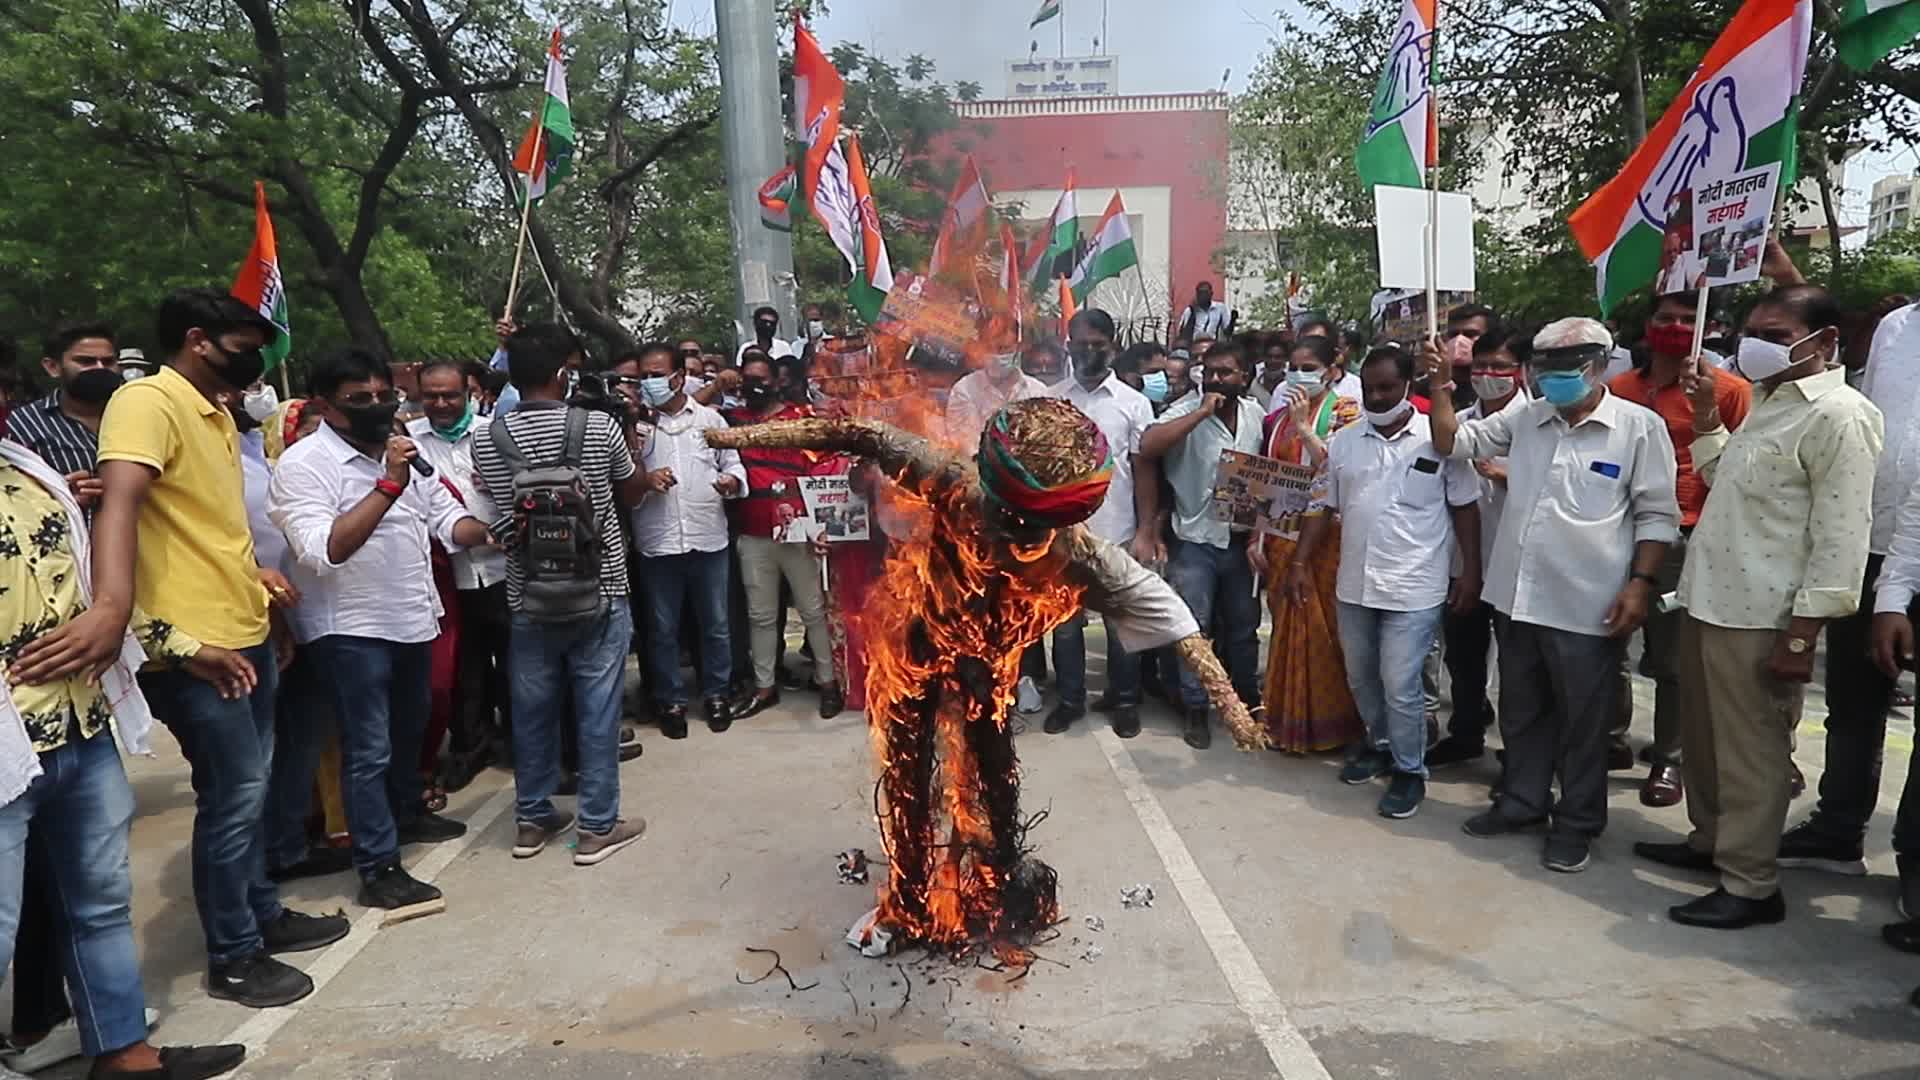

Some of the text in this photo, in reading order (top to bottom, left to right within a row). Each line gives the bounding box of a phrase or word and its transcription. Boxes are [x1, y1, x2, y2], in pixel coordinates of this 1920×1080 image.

[1698, 172, 1769, 204] मोदी मतलब
[1707, 196, 1748, 224] महंगाई
[805, 477, 826, 490] मोदी
[537, 528, 568, 538] LiveU
